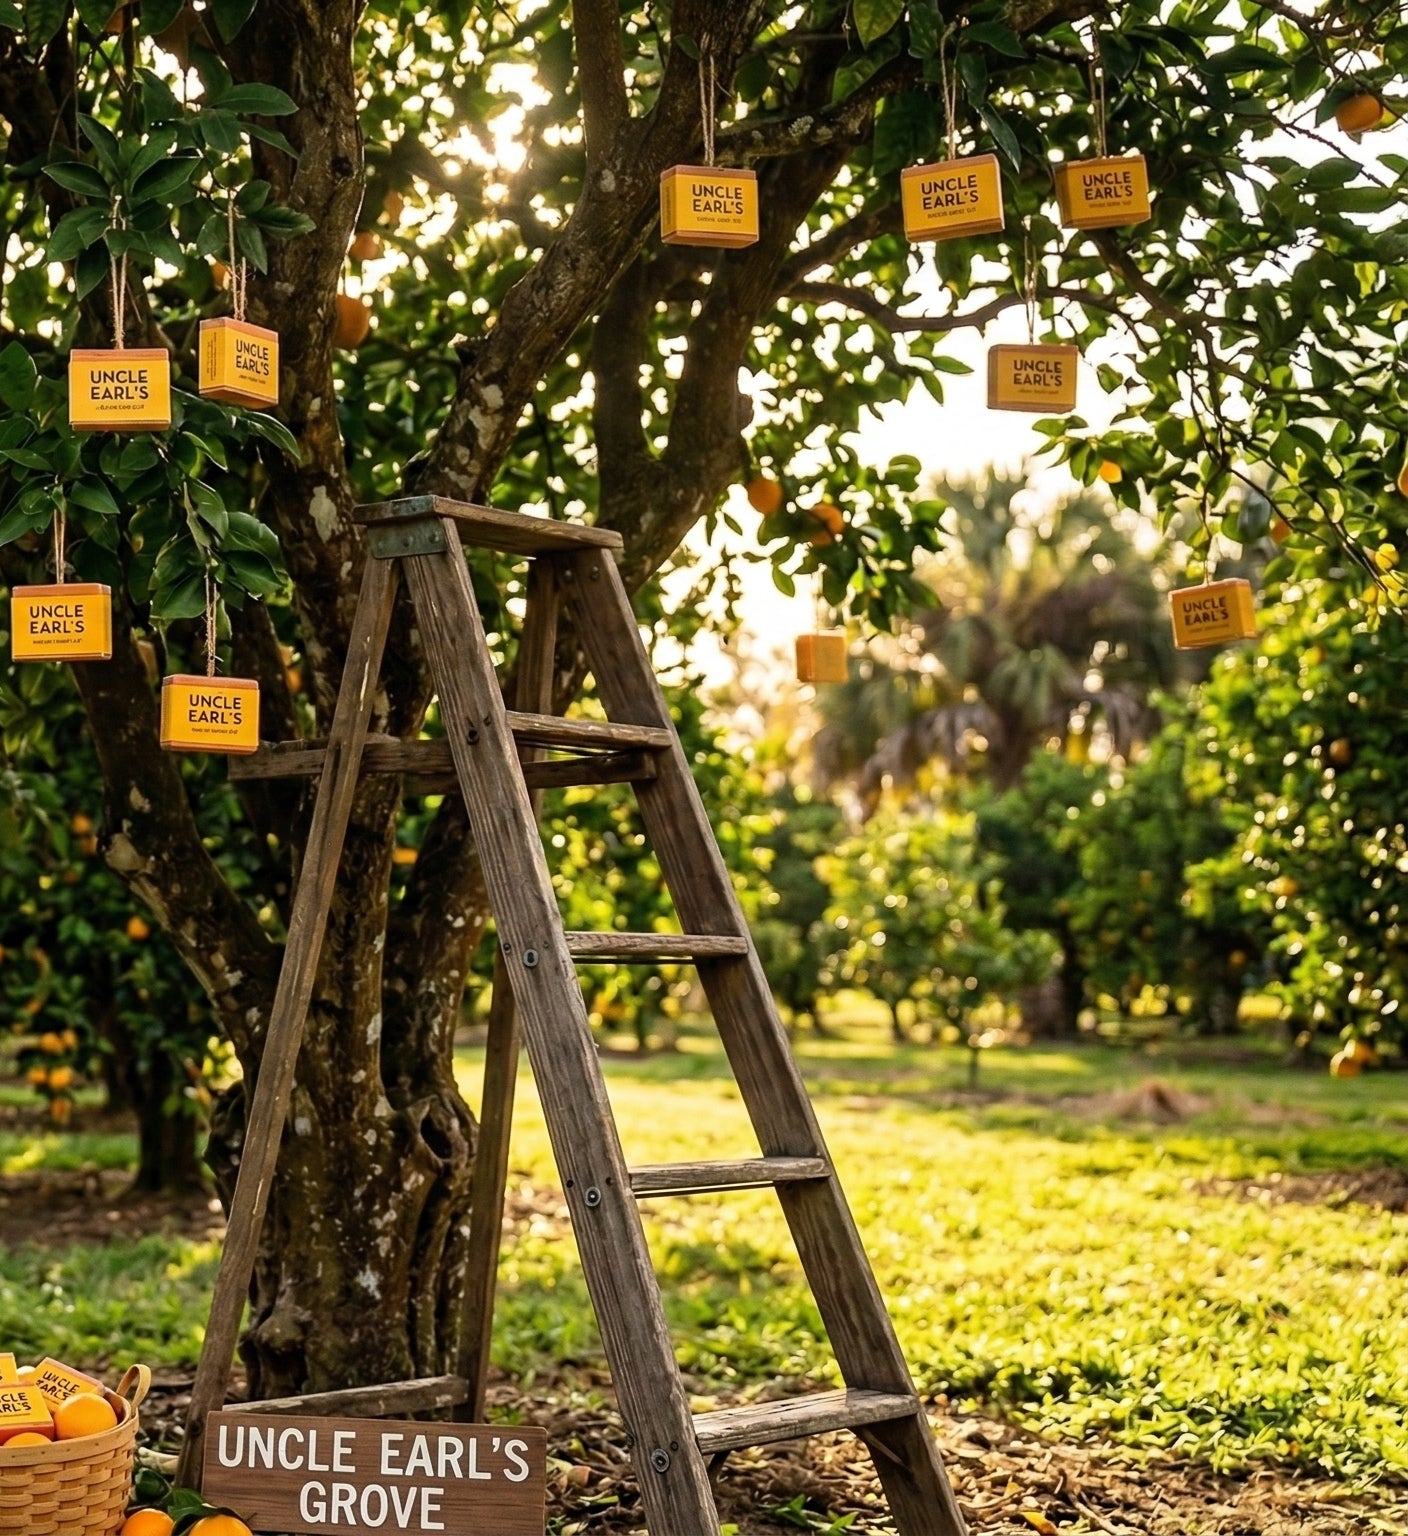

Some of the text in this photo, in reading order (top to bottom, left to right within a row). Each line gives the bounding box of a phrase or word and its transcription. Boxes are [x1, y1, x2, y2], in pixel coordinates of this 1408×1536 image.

[921, 175, 977, 195] UNCLE
[1083, 171, 1131, 187] UNCLE
[692, 184, 742, 199] UNCLE
[1084, 185, 1133, 200] EARL'S
[693, 200, 743, 214] EARL'S
[922, 190, 979, 210] EARL'S
[236, 339, 268, 360] UNCLE
[236, 354, 269, 375] EARL'S
[1014, 360, 1062, 373] UNCLE
[90, 370, 148, 383] UNCLE
[1013, 374, 1062, 386] EARL'S
[90, 386, 149, 400] EARL'S
[30, 605, 84, 618] UNCLE
[1182, 596, 1226, 612] UNCLE
[30, 620, 85, 633] EARL'S
[189, 694, 241, 709] UNCLE
[189, 710, 242, 725] EARL'S
[218, 1425, 529, 1482] UNCLE EARL'S
[300, 1481, 444, 1530] GROVE
